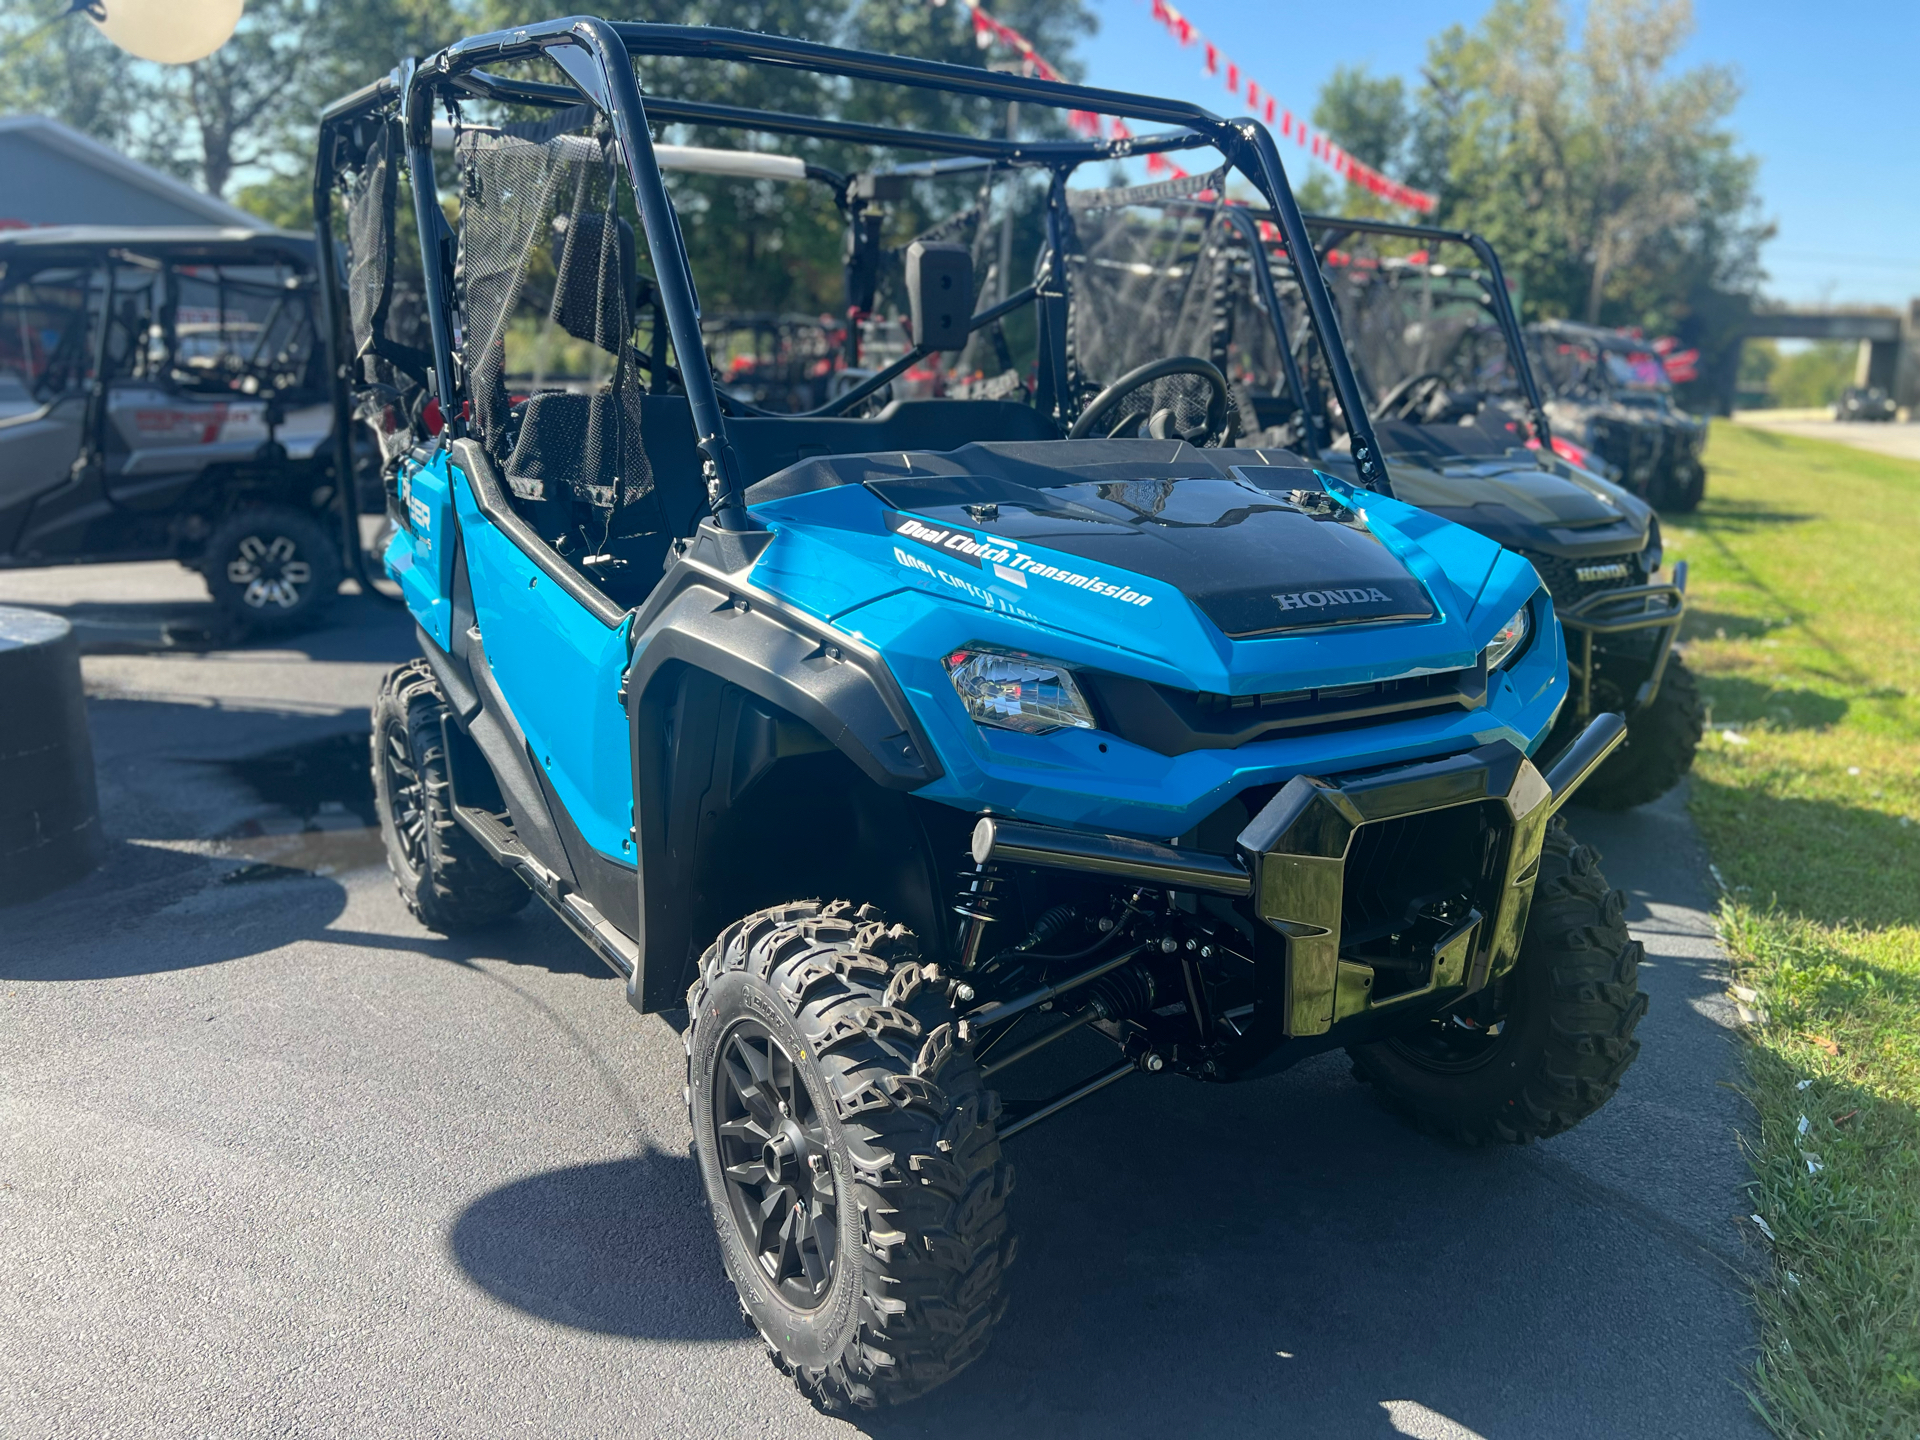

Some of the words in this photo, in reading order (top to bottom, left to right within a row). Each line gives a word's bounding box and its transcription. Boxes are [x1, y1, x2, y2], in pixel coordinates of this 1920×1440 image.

[897, 519, 949, 544] Dual
[949, 534, 1009, 563] Clutch
[1008, 552, 1153, 607] Transmission
[1576, 563, 1629, 581] HONDA
[1272, 587, 1392, 611] HONDA
